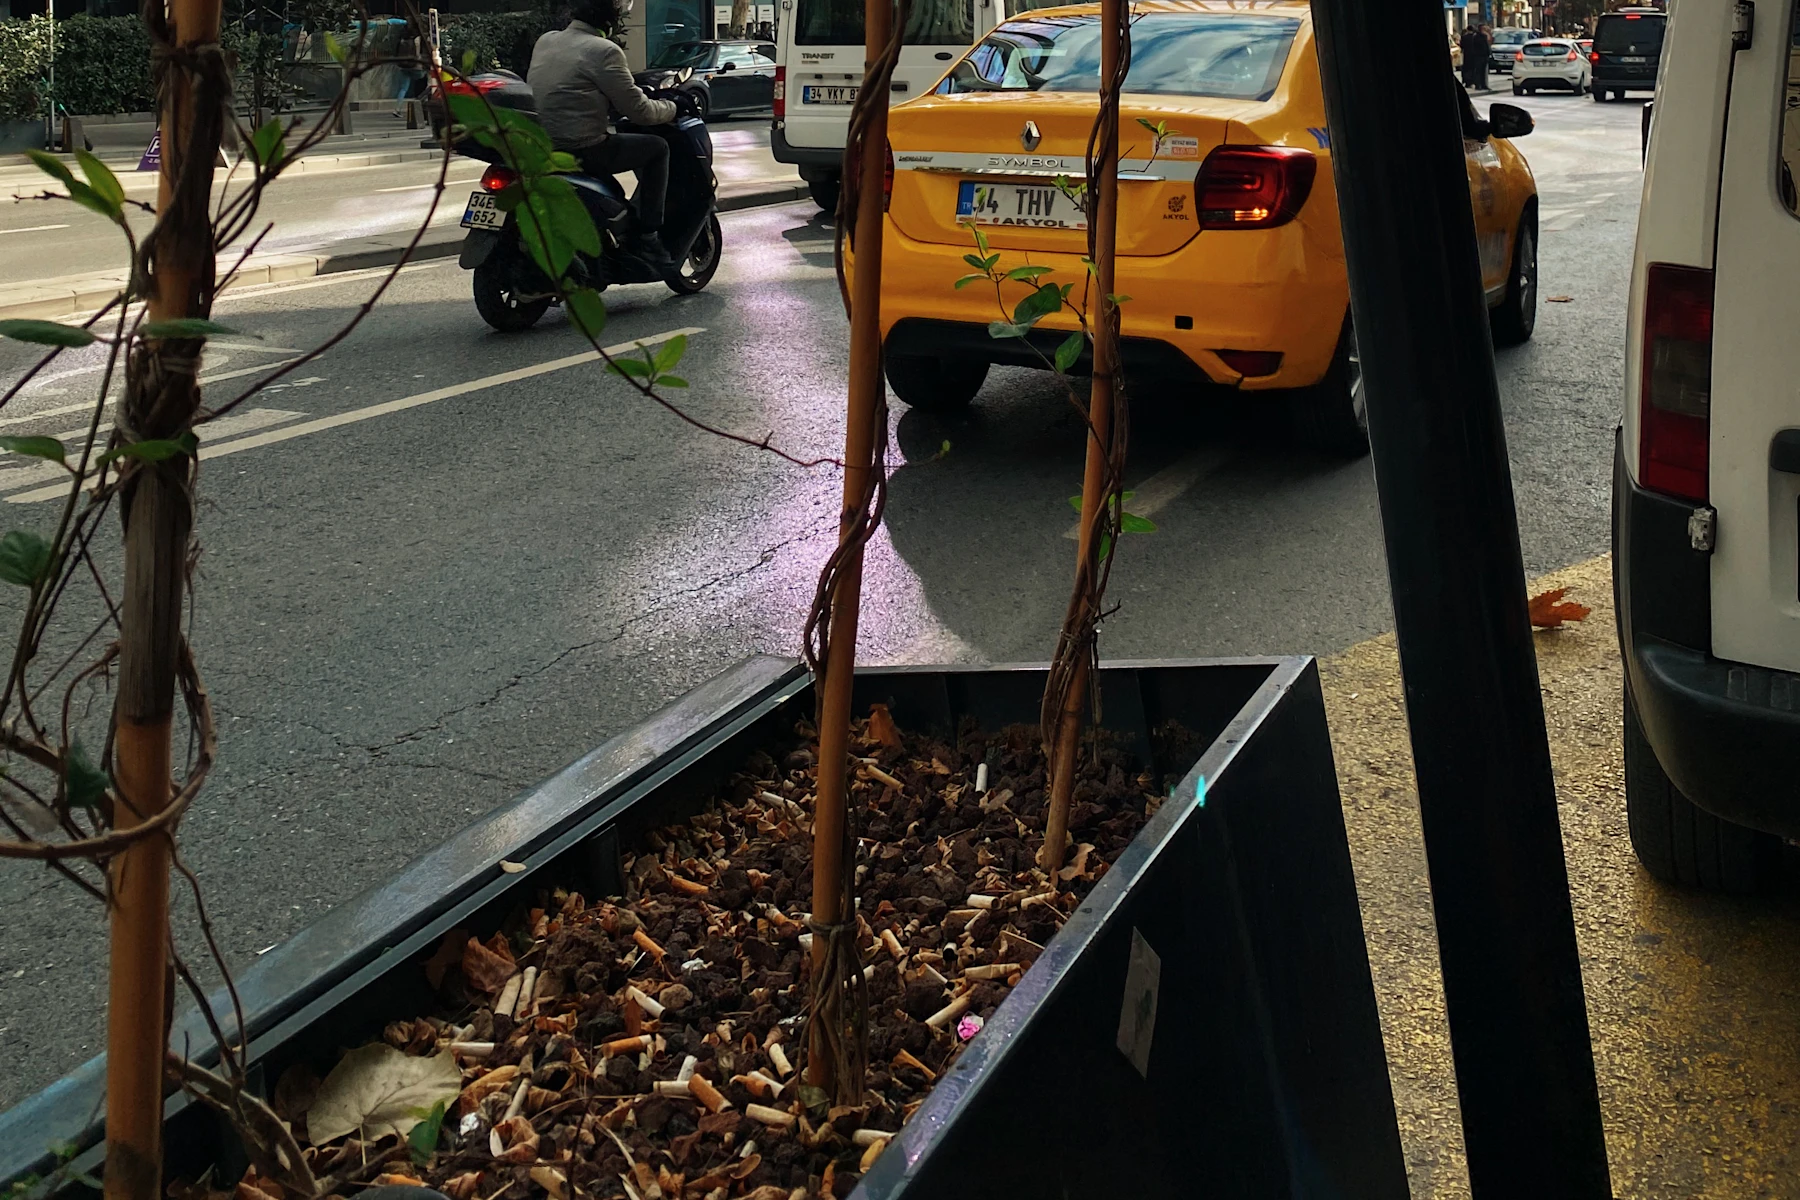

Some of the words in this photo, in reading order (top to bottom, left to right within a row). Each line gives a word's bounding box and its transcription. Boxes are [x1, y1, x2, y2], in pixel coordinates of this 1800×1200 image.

[810, 88, 822, 100] 34
[827, 88, 845, 100] VKY
[849, 88, 859, 100] 8
[988, 157, 1071, 169] SYMBOL
[471, 195, 496, 210] 34E
[1016, 188, 1056, 216] THV
[473, 210, 497, 224] 652
[1002, 217, 1070, 229] AKYOL
[1162, 213, 1190, 221] AKYOL
